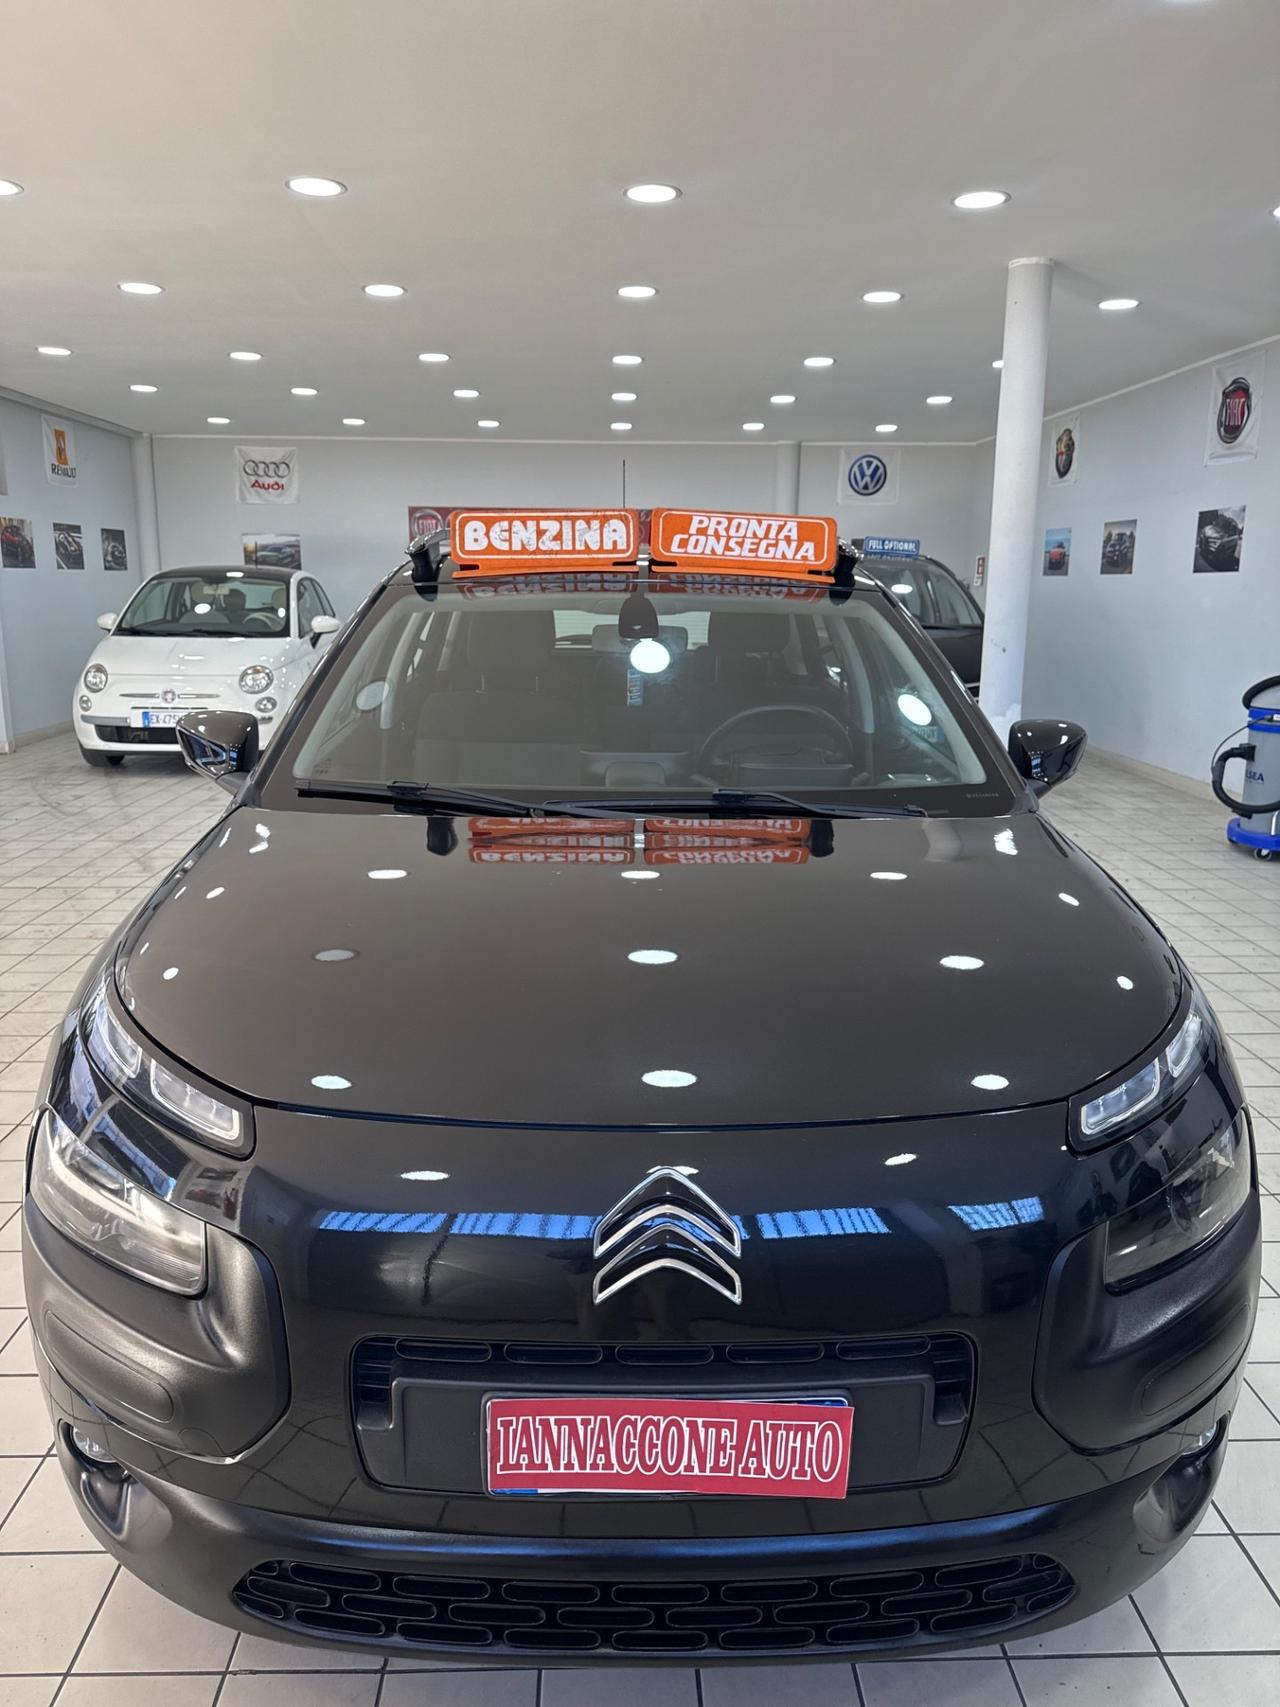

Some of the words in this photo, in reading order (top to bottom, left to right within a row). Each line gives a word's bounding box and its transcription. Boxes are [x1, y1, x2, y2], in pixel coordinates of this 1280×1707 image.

[1225, 398, 1246, 426] FIAT
[250, 479, 285, 491] Audi
[464, 519, 627, 551] BENZINA
[688, 515, 798, 539] PRONTA
[670, 534, 815, 561] CONSEGNA
[868, 539, 883, 550] FULL
[884, 540, 916, 552] OPTIONAL
[496, 1414, 737, 1477] IANNACCONE
[737, 1419, 844, 1483] AUTO
